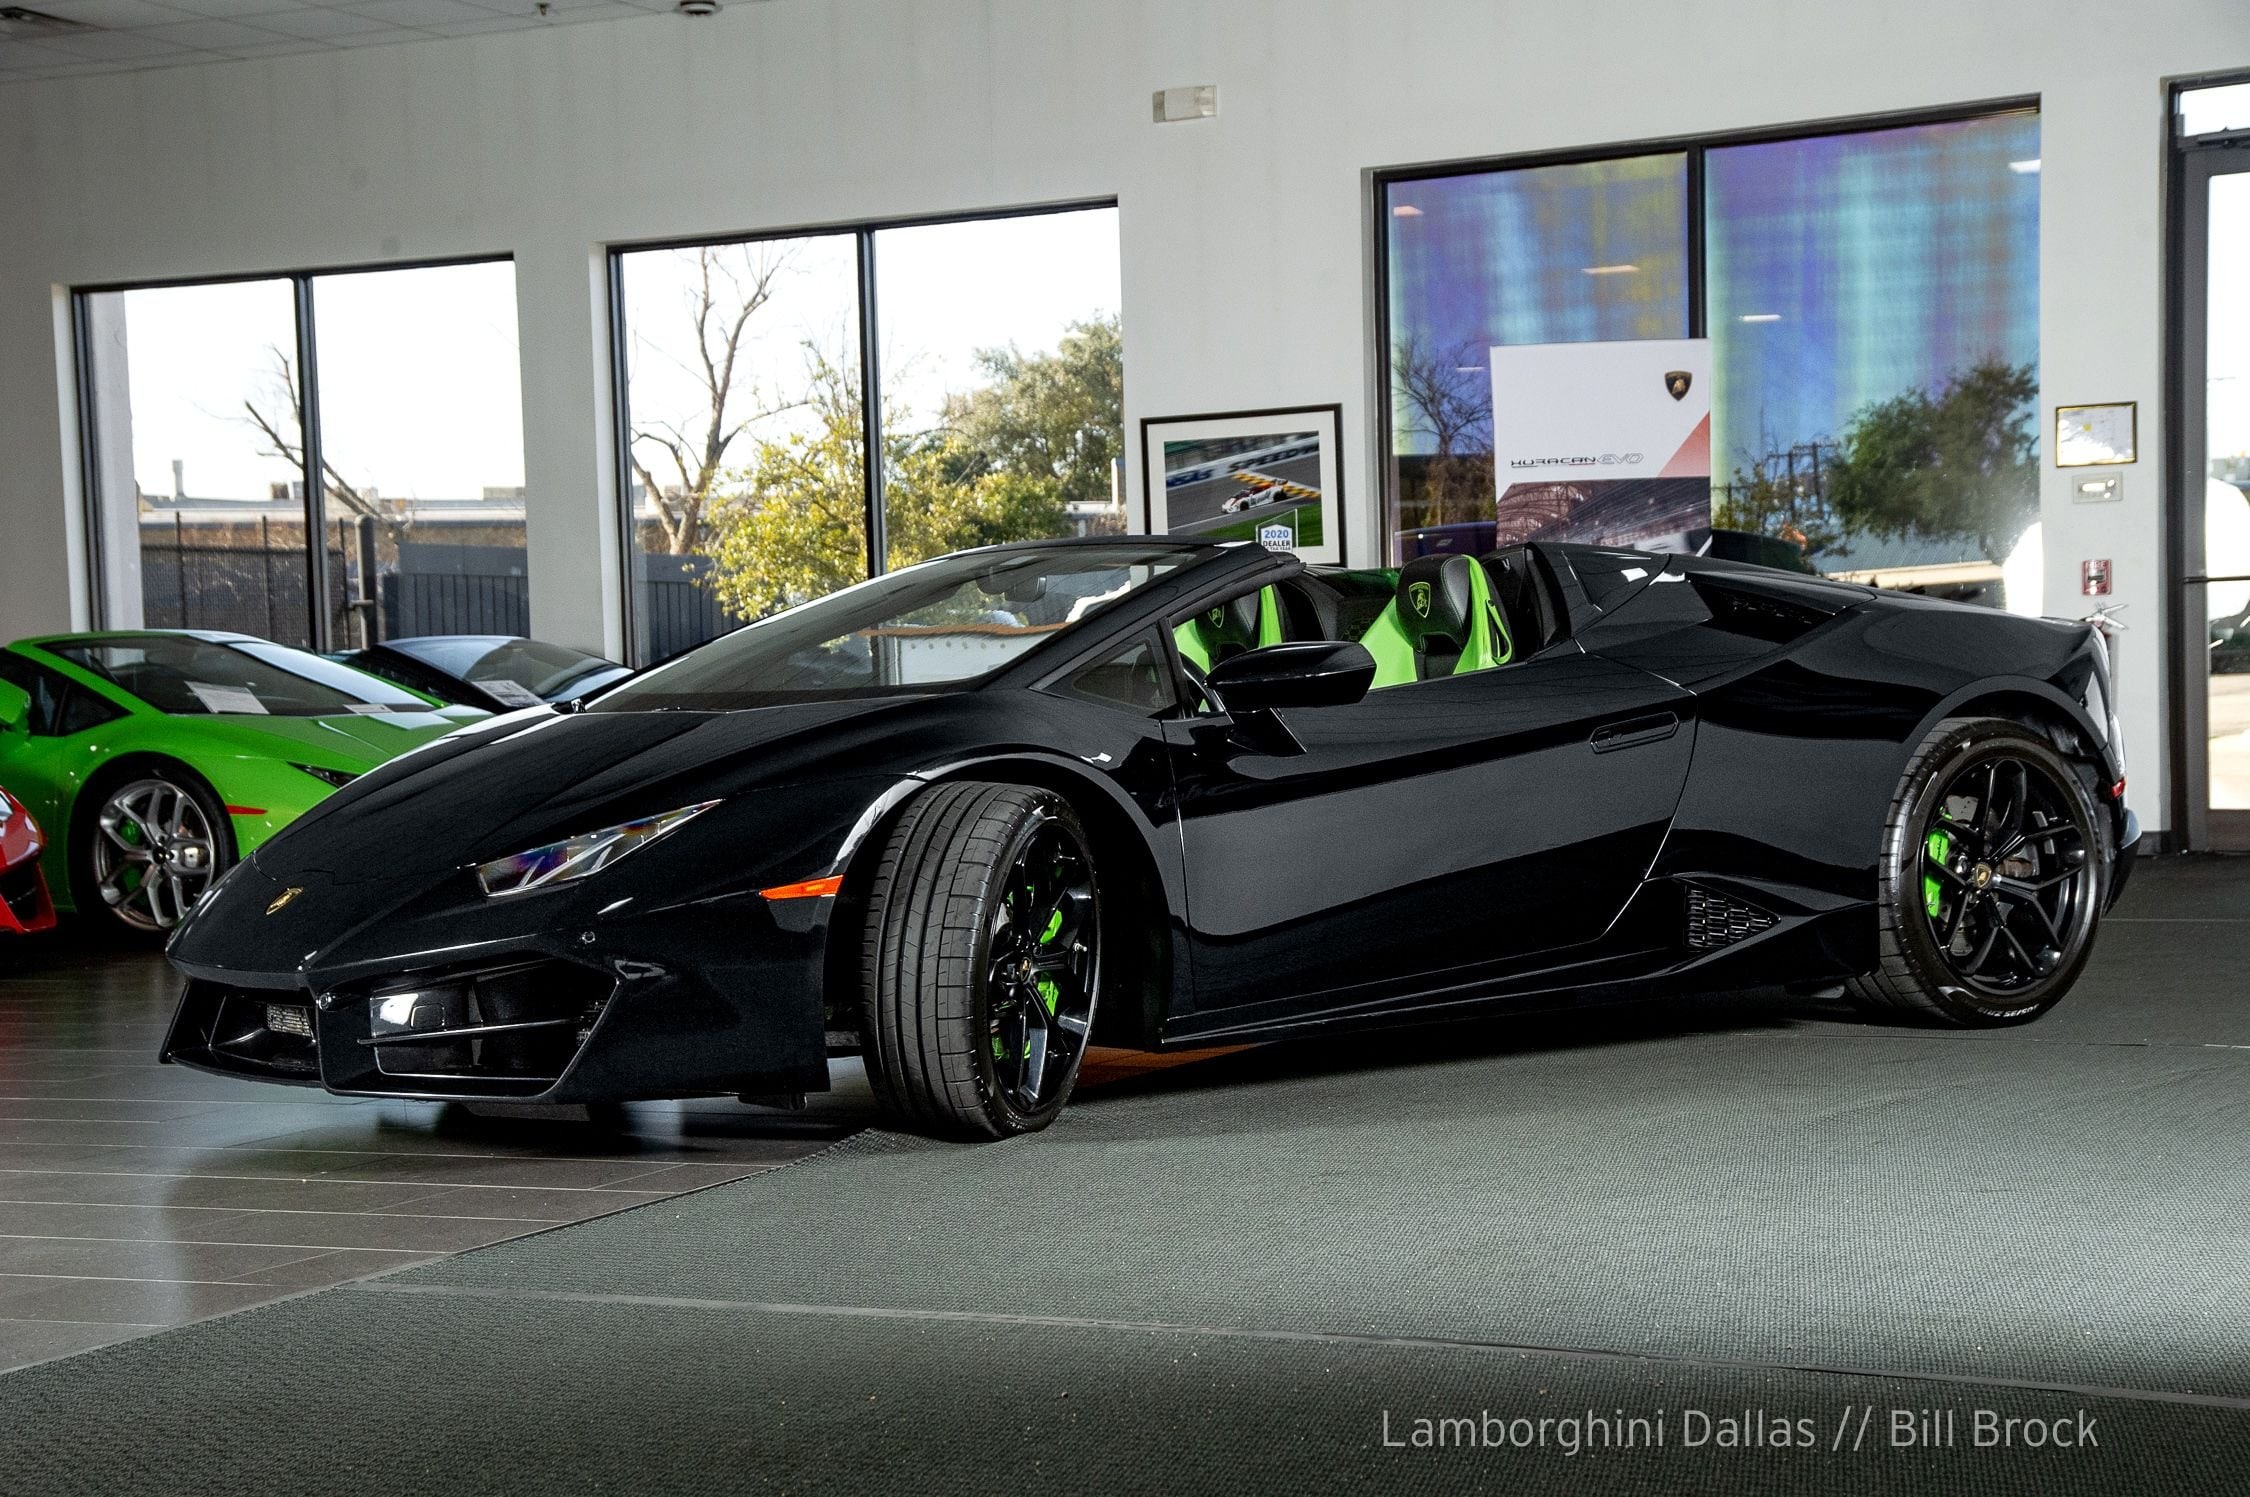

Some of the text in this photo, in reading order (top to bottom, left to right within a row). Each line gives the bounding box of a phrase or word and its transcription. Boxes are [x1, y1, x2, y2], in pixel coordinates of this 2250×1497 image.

[1511, 453, 1644, 466] HURACAN EVO
[1264, 529, 1289, 539] 2020
